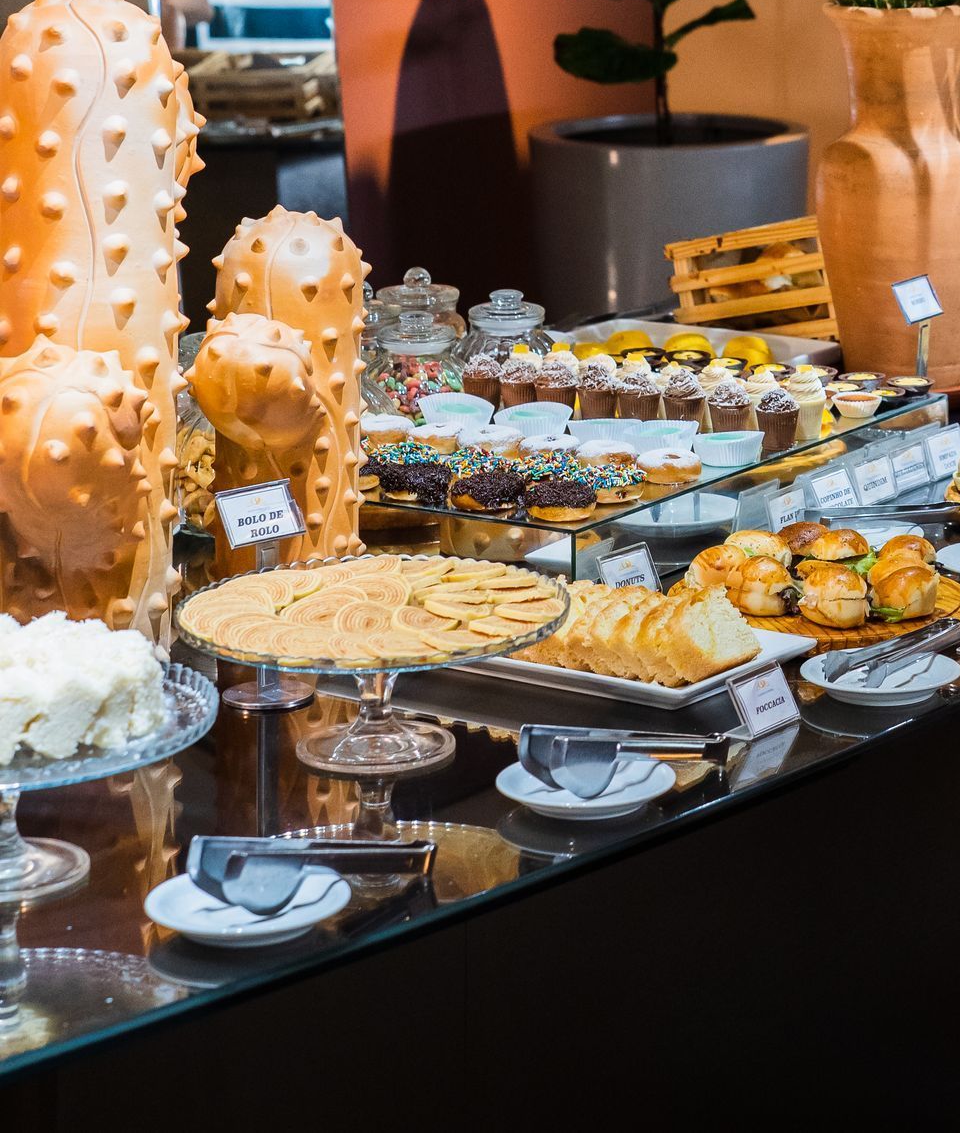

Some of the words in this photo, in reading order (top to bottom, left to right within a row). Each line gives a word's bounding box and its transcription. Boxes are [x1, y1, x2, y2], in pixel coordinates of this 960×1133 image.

[844, 487, 851, 496] DE
[237, 513, 266, 527] BOLO
[269, 510, 284, 521] DE
[780, 512, 794, 524] FLAN
[250, 524, 280, 538] ROLO
[615, 573, 645, 589] DONUTS
[756, 696, 786, 715] FOCCACIA
